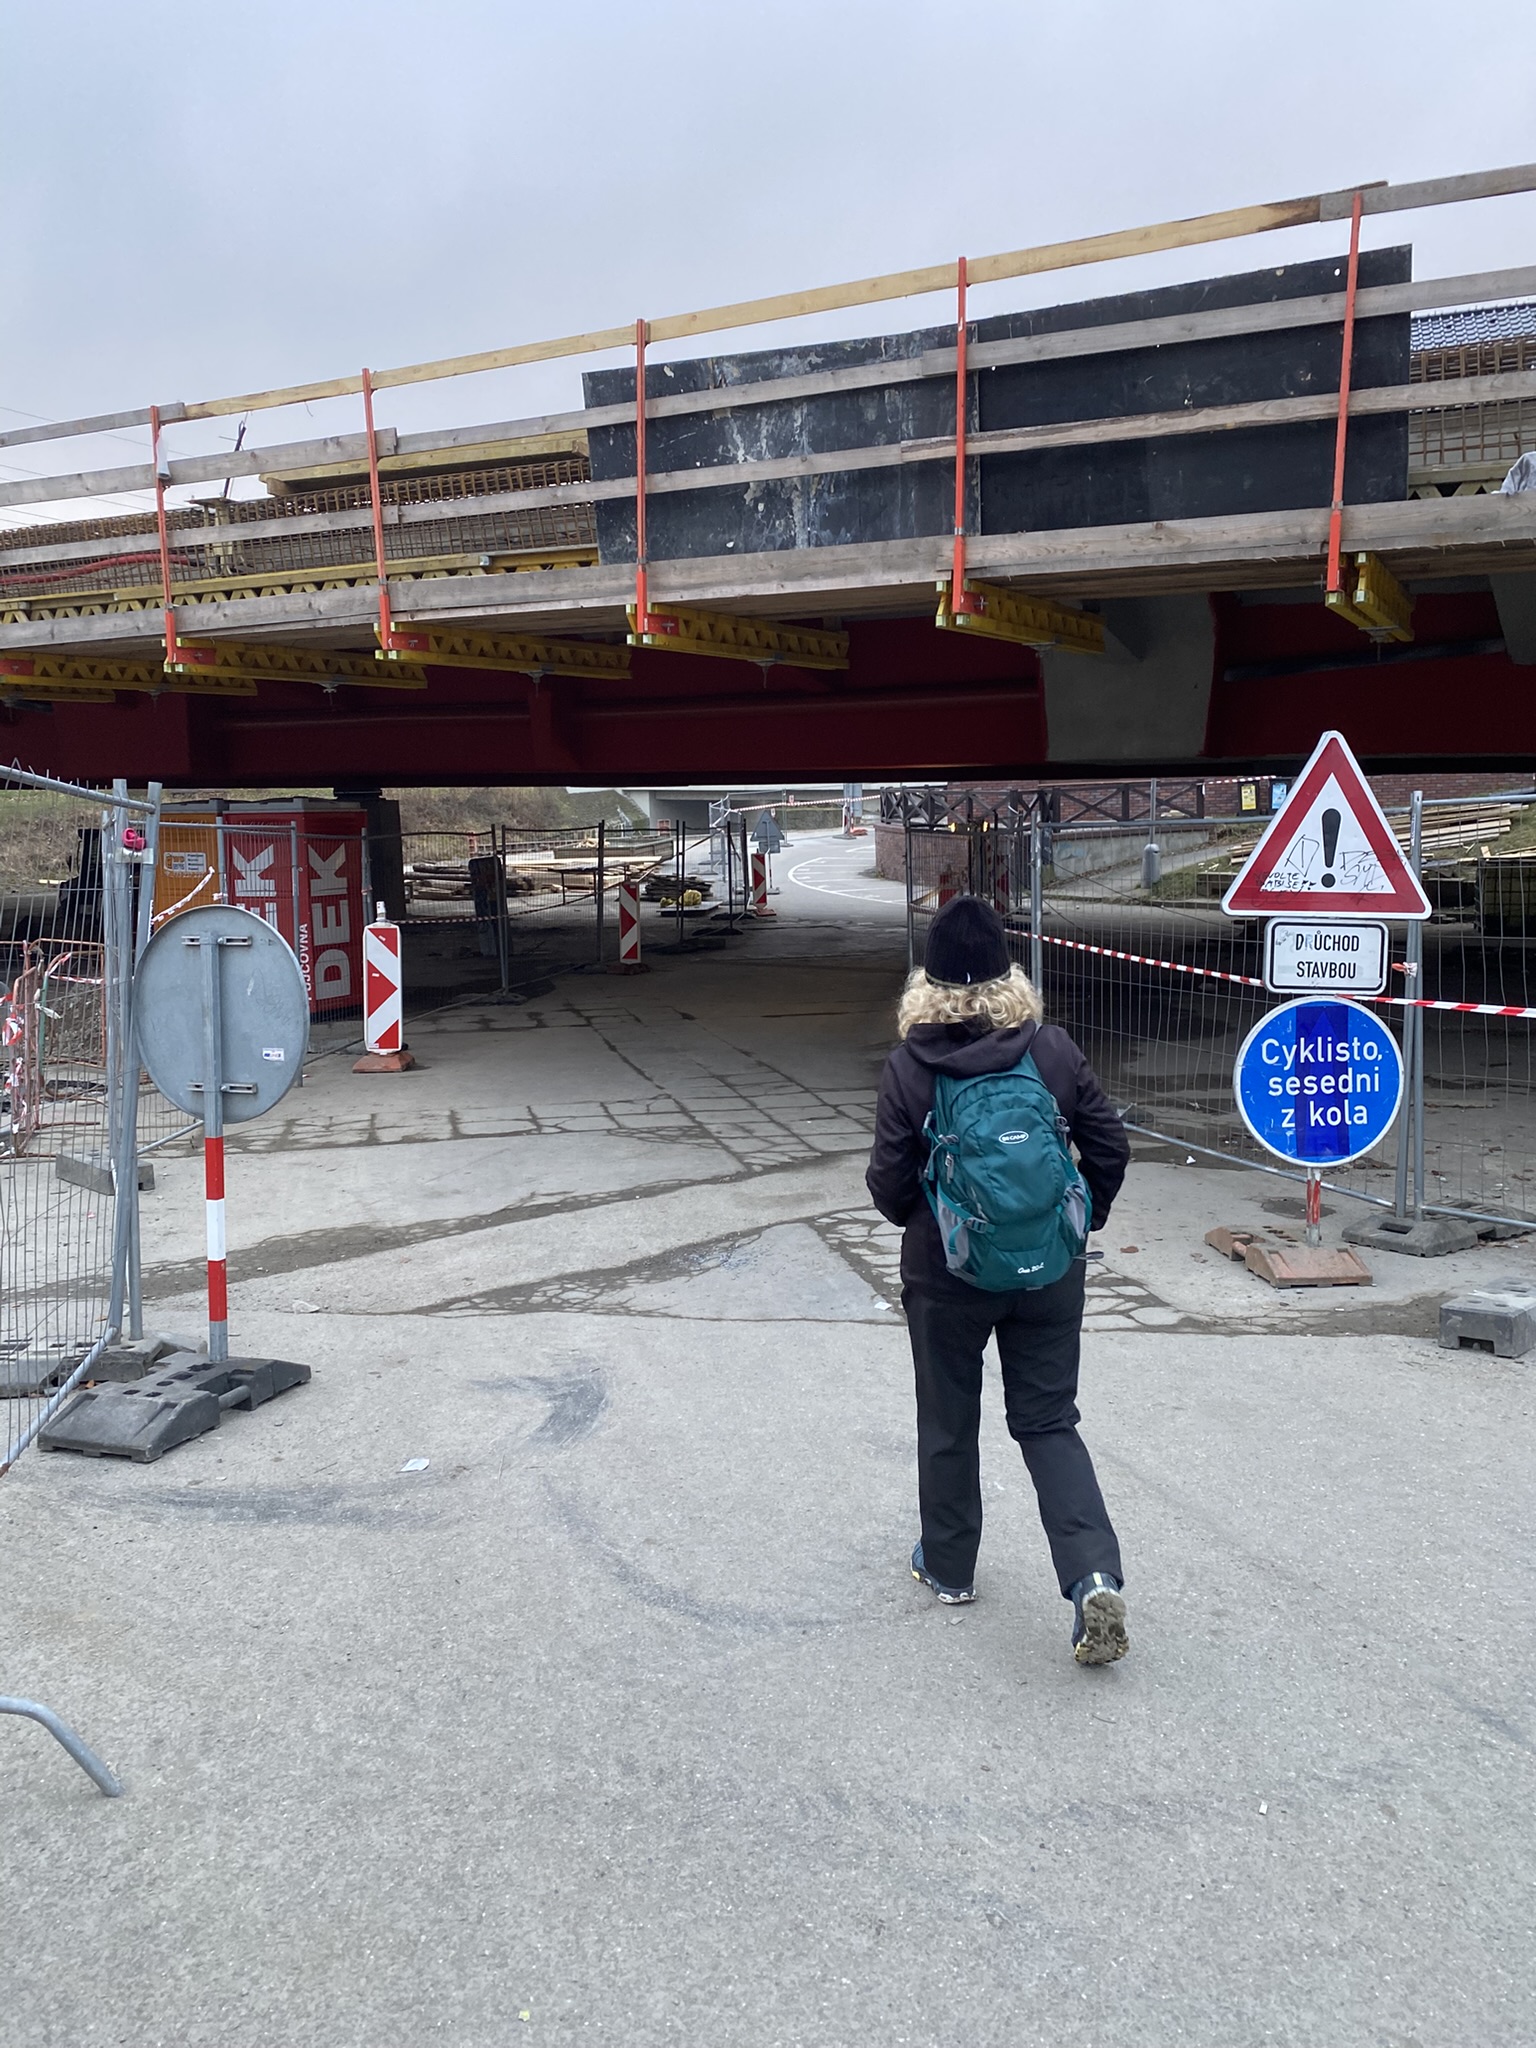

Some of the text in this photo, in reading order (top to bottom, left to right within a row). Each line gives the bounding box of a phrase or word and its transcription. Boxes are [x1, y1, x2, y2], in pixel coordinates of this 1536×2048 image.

[307, 843, 351, 1000] DEK
[1296, 961, 1357, 979] STAVBOU
[1261, 1036, 1383, 1071] Cyklisto,
[1268, 1066, 1380, 1096] sesedni
[1281, 1099, 1368, 1128] z kola
